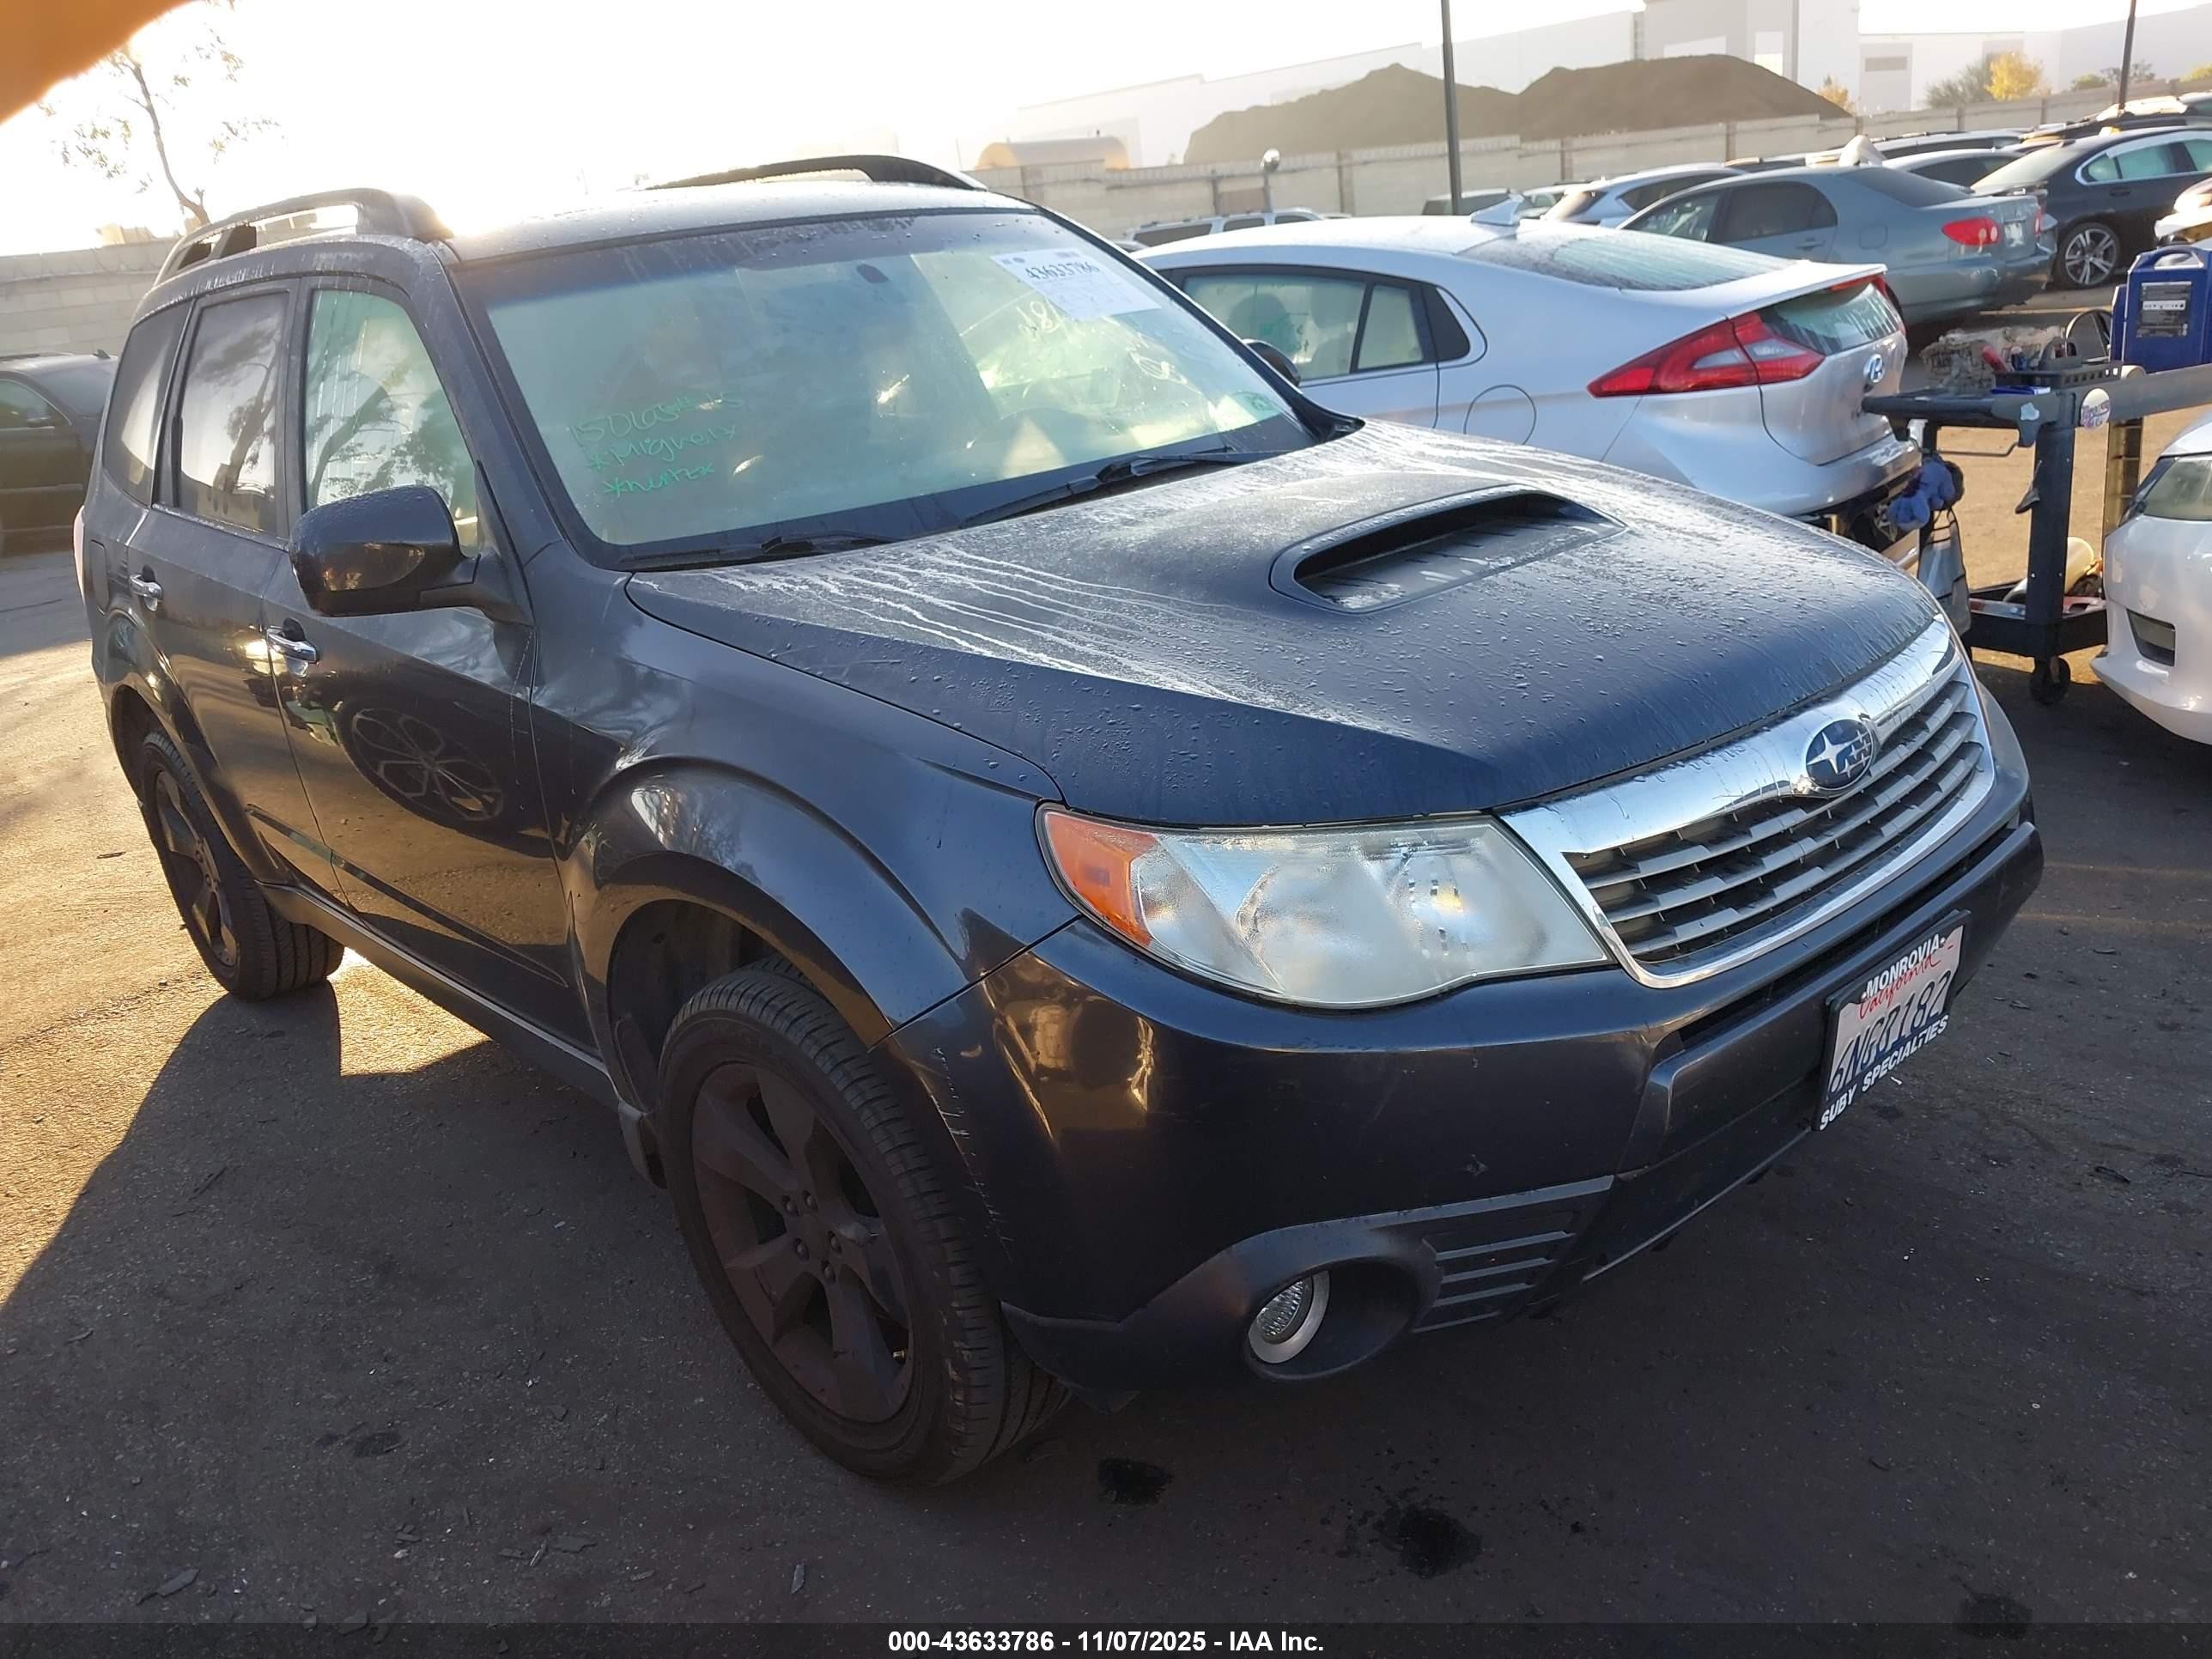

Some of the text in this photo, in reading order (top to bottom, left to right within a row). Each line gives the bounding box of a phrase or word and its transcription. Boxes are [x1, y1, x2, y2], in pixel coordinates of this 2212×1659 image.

[1024, 261, 1100, 280] 43633786
[1864, 933, 1940, 997] MONROVIA
[1819, 1014, 1950, 1132] SUBY SPECIALTIES
